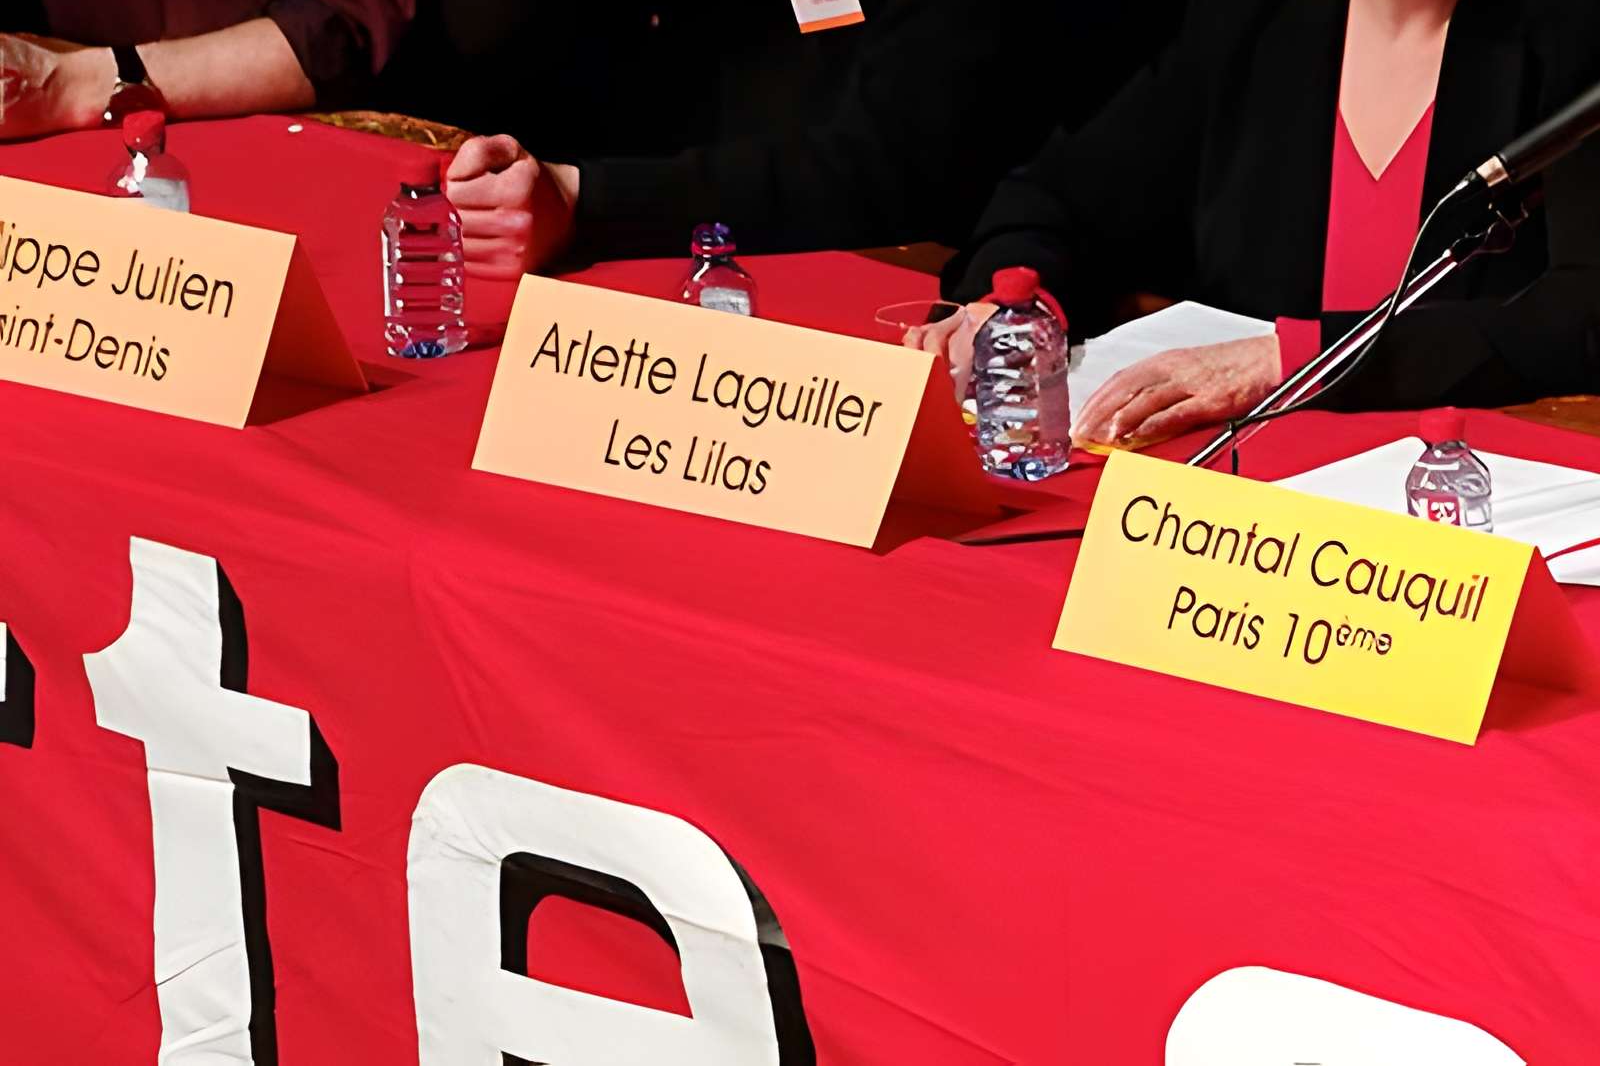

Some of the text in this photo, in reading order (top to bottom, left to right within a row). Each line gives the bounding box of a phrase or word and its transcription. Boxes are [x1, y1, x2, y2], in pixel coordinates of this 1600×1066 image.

[0, 220, 234, 317] ippe Julien
[529, 322, 882, 436] Arlette Laguiller
[604, 419, 772, 494] Les Lilas
[1121, 495, 1489, 621] Chantal Cauquil
[1168, 586, 1392, 665] Paris 10ème
